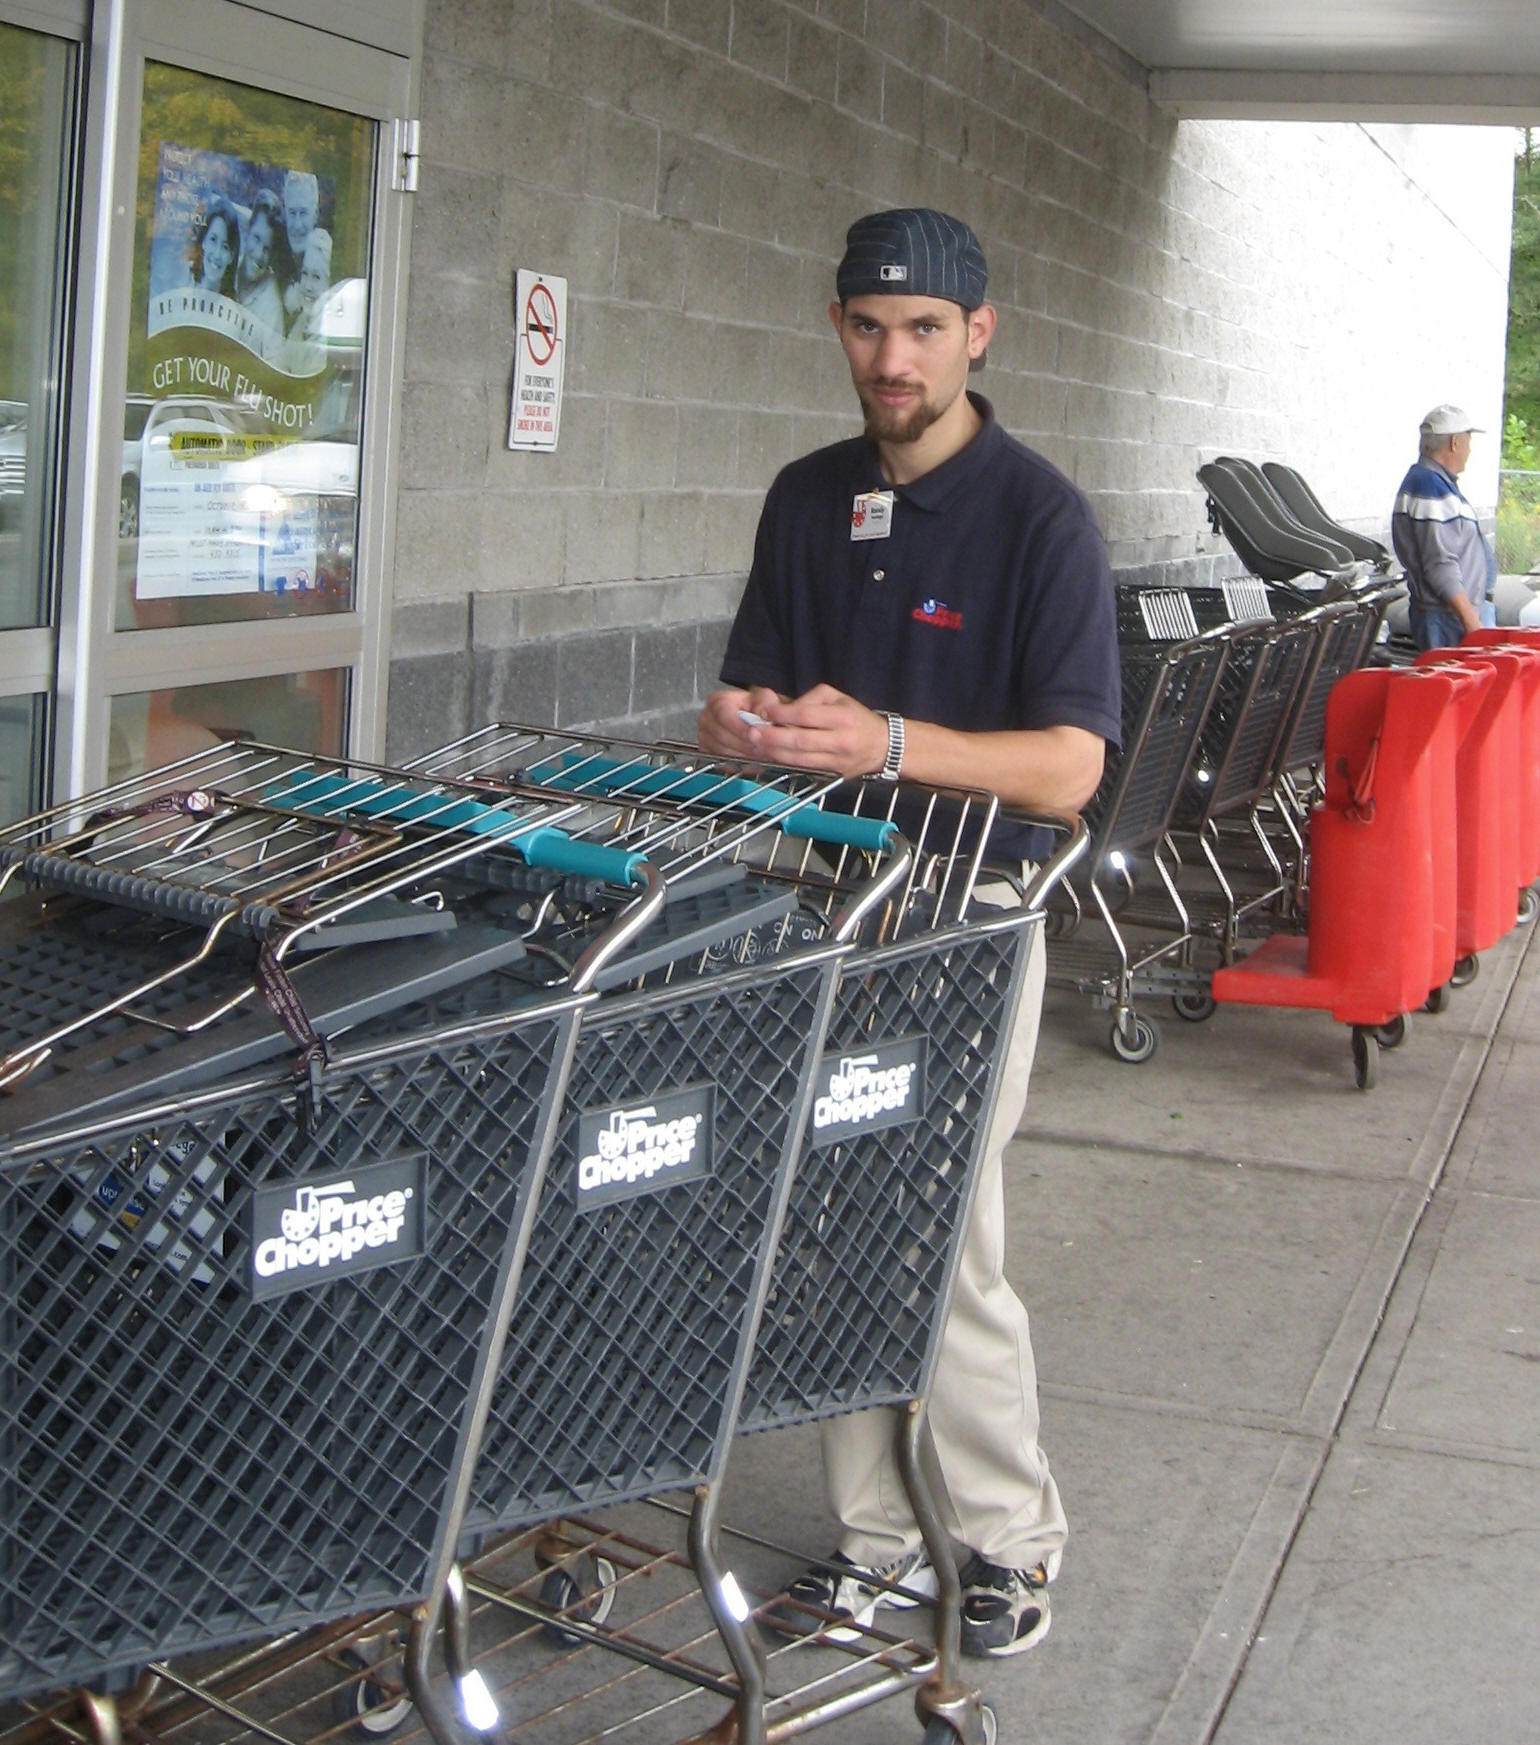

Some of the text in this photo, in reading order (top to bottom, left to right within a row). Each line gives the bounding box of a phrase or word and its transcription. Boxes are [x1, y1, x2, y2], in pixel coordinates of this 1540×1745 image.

[153, 357, 313, 428] GET YOUR FLU SHOT!
[181, 437, 224, 450] AUTOMATIC
[854, 1065, 911, 1096] Price
[813, 1086, 910, 1129] Chopper
[626, 1115, 697, 1153] Price
[578, 1138, 696, 1191] Chopper
[319, 1190, 407, 1236] Price
[254, 1215, 406, 1277] Chopper
